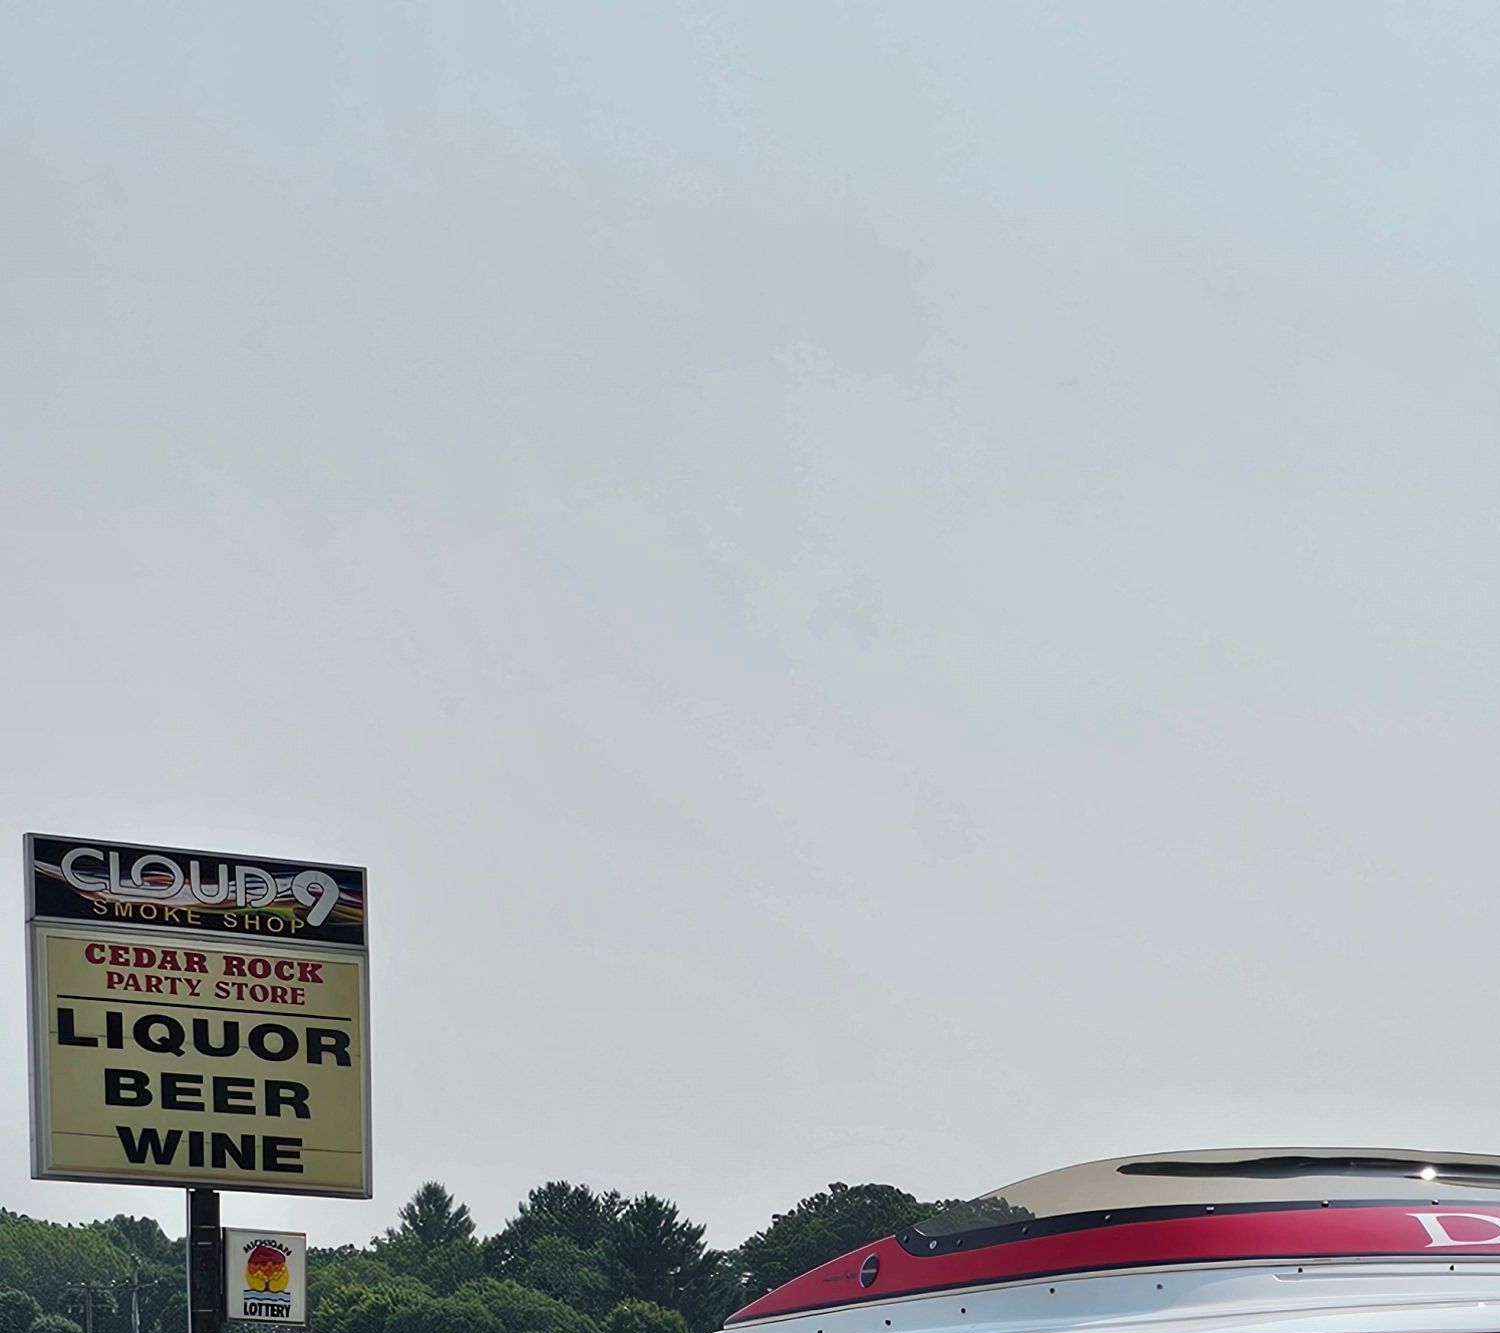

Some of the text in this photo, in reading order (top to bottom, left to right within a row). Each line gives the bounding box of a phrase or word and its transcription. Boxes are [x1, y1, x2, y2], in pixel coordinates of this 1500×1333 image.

[61, 847, 340, 927] CLOUD 9
[94, 900, 305, 934] SMOKE SHOP
[85, 943, 324, 984] CEDAR ROCK
[106, 971, 305, 1006] PARTY STORE
[57, 1007, 352, 1067] LIQUOR
[104, 1068, 312, 1119] BEER
[115, 1126, 304, 1174] WINE
[243, 1302, 291, 1318] LOTTERY
